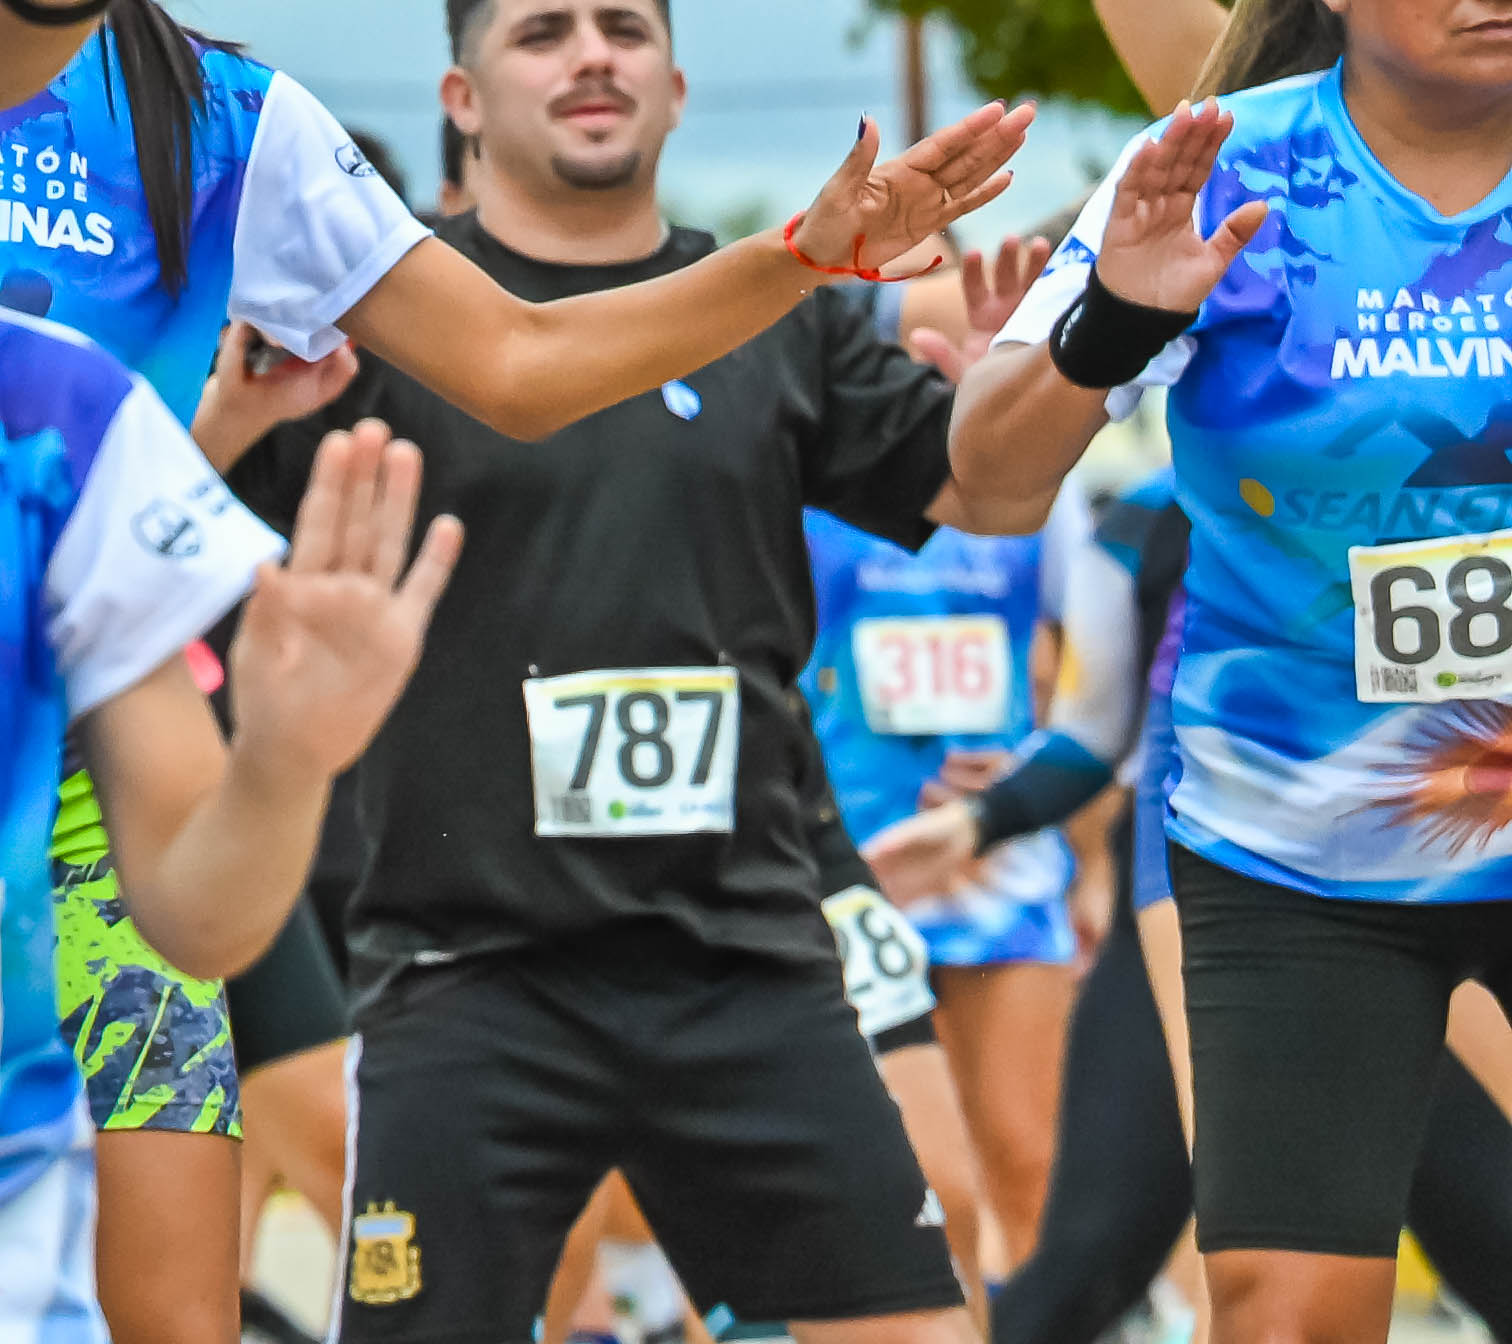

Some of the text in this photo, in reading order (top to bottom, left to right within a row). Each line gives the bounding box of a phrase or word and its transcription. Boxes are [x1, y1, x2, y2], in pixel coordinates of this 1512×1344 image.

[45, 177, 88, 203] DE
[1356, 287, 1512, 315] MARAT
[1330, 337, 1512, 380] MALVIN
[875, 630, 993, 705] 316
[554, 690, 723, 792] 787
